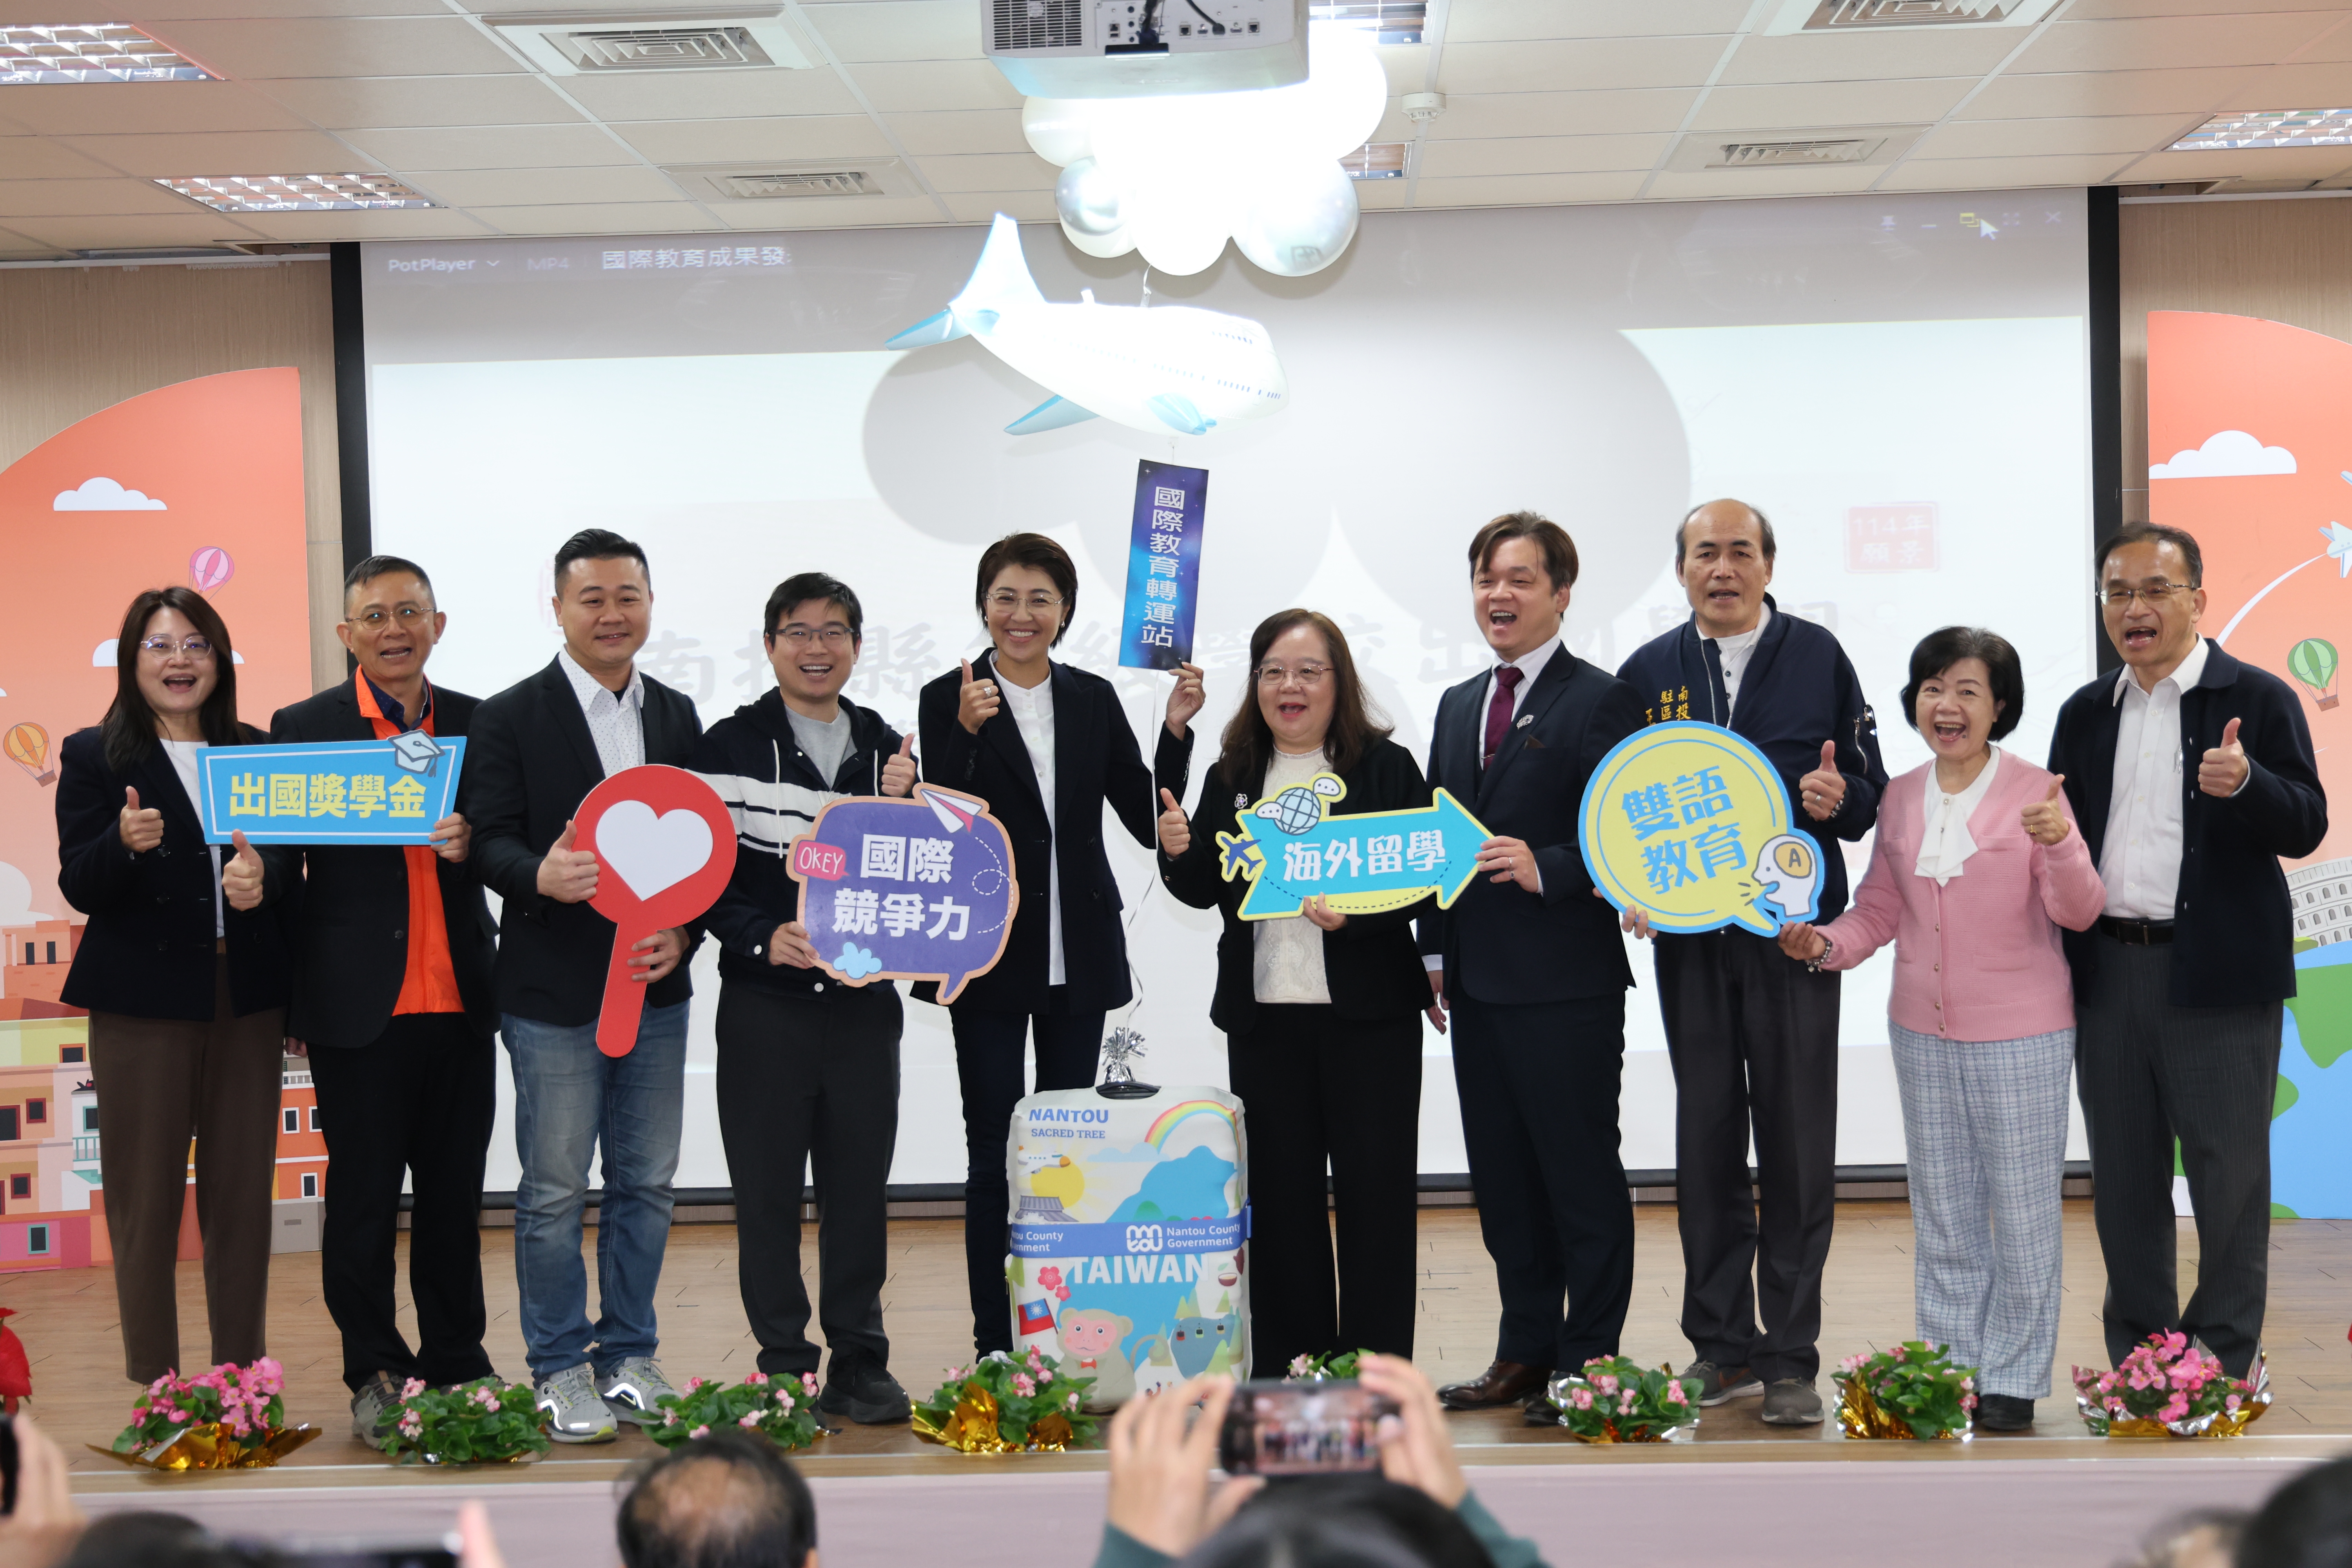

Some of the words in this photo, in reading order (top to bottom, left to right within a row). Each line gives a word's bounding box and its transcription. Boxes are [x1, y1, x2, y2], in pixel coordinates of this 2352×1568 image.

[388, 258, 475, 273] PotPlayer
[527, 258, 570, 270] MP4
[1853, 514, 1930, 536] 114年
[1860, 540, 1925, 564] 願景
[1141, 486, 1185, 648] 國際教育轉運站
[230, 772, 426, 818] 出國獎學金
[1621, 765, 1733, 841] 雙語
[860, 833, 955, 884] 國際
[1283, 829, 1446, 882] 海外留學
[1640, 822, 1747, 895] 教育
[1788, 848, 1801, 868] A
[832, 887, 971, 941] 競爭力
[1029, 1109, 1109, 1123] NANTOU
[1031, 1129, 1074, 1138] SACRED
[1077, 1130, 1105, 1138] TREE
[1026, 1232, 1063, 1242] County
[1167, 1227, 1205, 1236] Nantou
[1209, 1223, 1240, 1234] County
[1167, 1236, 1233, 1248] Government
[1068, 1253, 1209, 1283] TAIWAN
